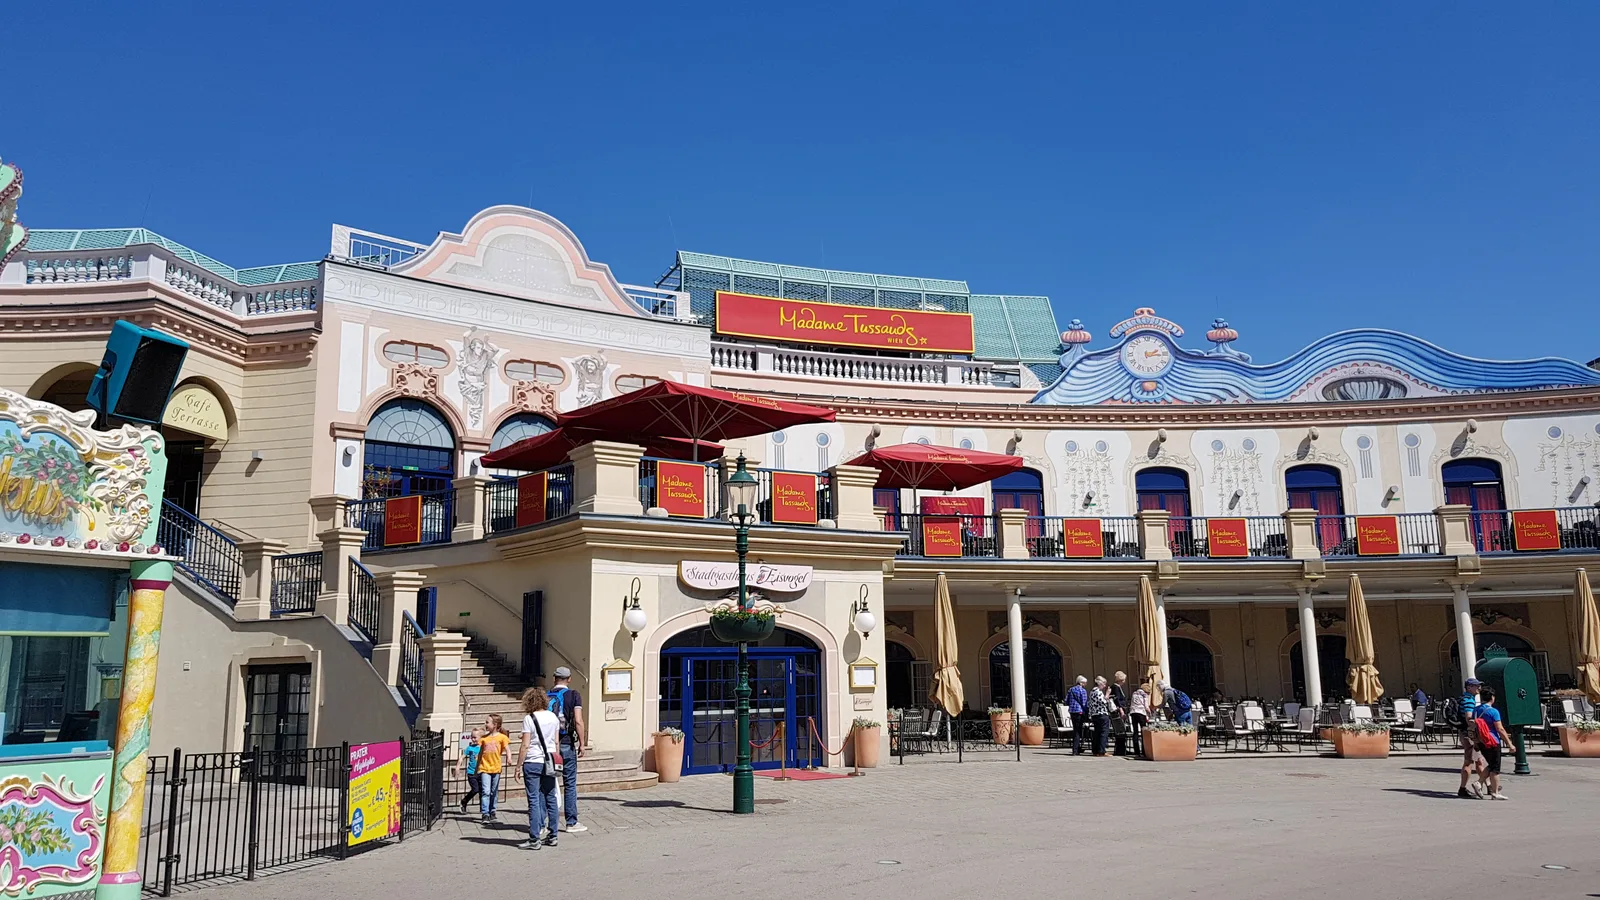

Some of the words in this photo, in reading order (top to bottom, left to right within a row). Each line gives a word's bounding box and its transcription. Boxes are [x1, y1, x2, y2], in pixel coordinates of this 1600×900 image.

[780, 307, 847, 332] Madame
[843, 314, 918, 346] Tussauds
[171, 407, 220, 431] Terrasse
[662, 475, 694, 487] Madame
[664, 487, 698, 504] Tussauds
[776, 484, 807, 496] Madame
[778, 496, 811, 512] Tussauds
[927, 525, 952, 535] Madame
[1360, 525, 1388, 535] Madame
[1517, 520, 1547, 529] Madame
[1067, 527, 1093, 536] Madame
[1211, 527, 1238, 536] Madame
[1519, 528, 1553, 540] Tussauds
[928, 535, 957, 547] Tussauds
[1068, 536, 1097, 548] Tussauds
[1212, 536, 1243, 548] Tussauds
[1361, 533, 1393, 545] Tussauds
[757, 565, 810, 590] Eisvogel
[350, 746, 368, 762] PRATER
[353, 756, 376, 774] Highlights
